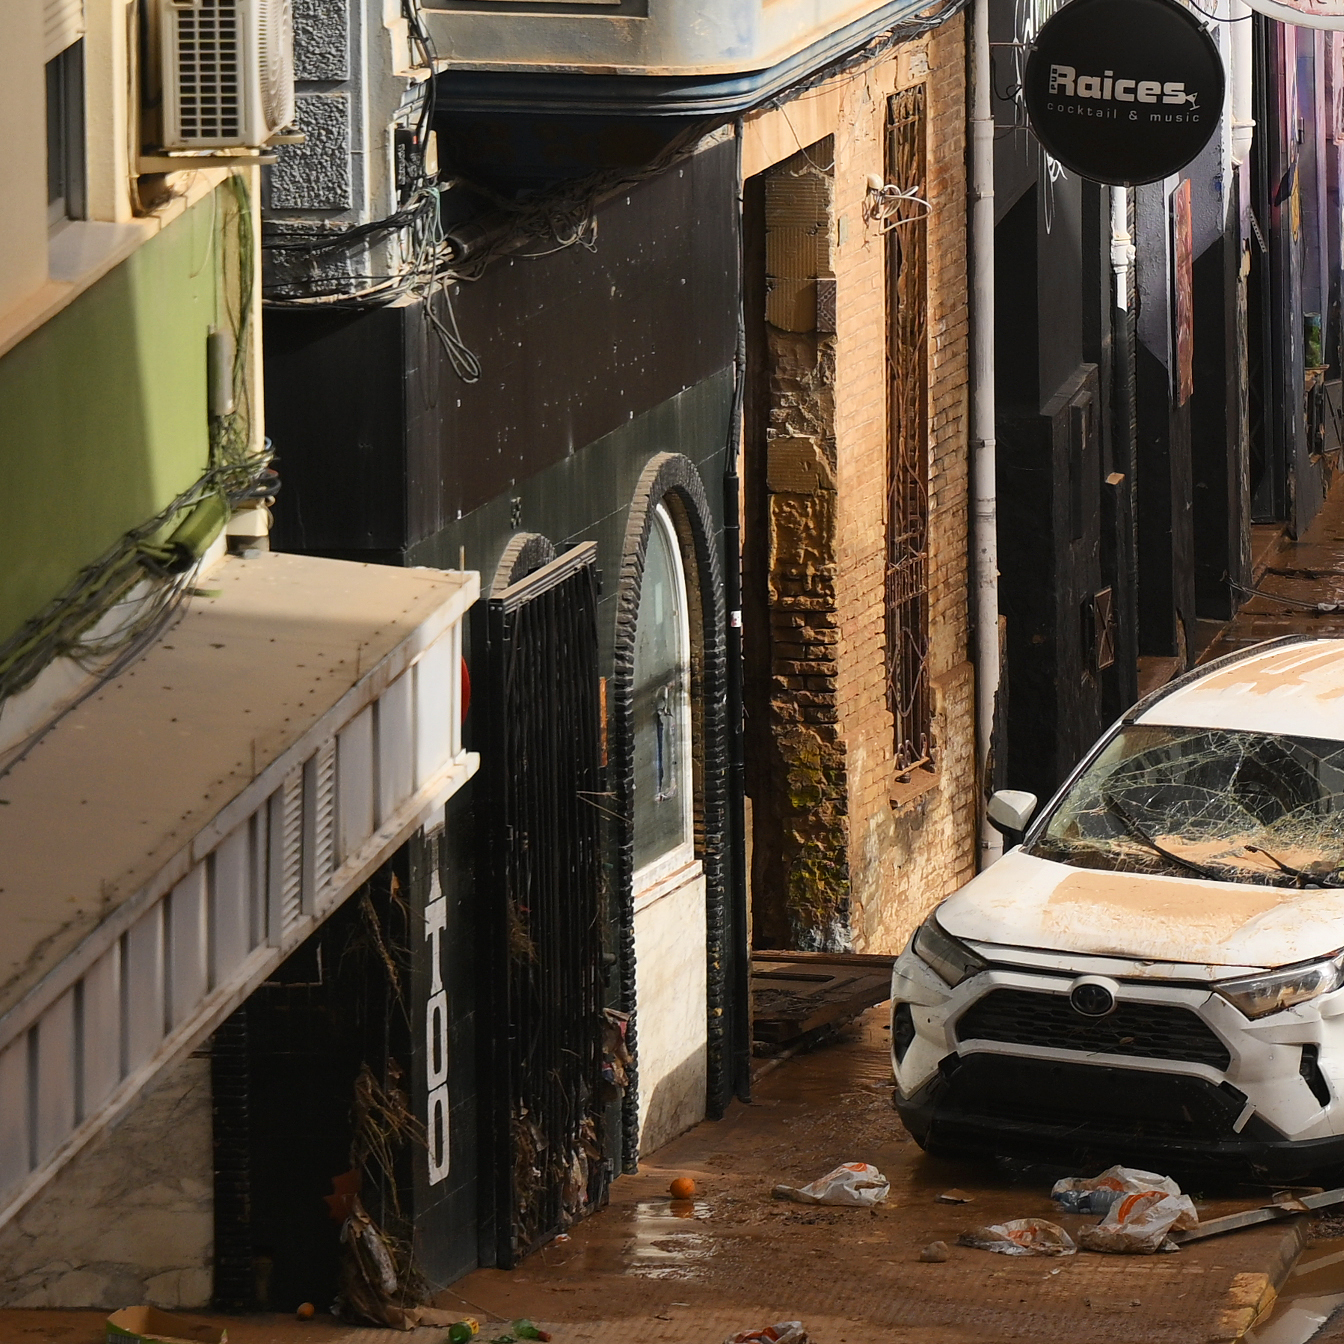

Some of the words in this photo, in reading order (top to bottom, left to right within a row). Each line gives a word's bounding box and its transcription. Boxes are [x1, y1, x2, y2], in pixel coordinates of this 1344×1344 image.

[1049, 64, 1187, 105] Raices
[1047, 102, 1117, 119] cocktail
[1128, 110, 1138, 121] &
[1150, 112, 1200, 123] music
